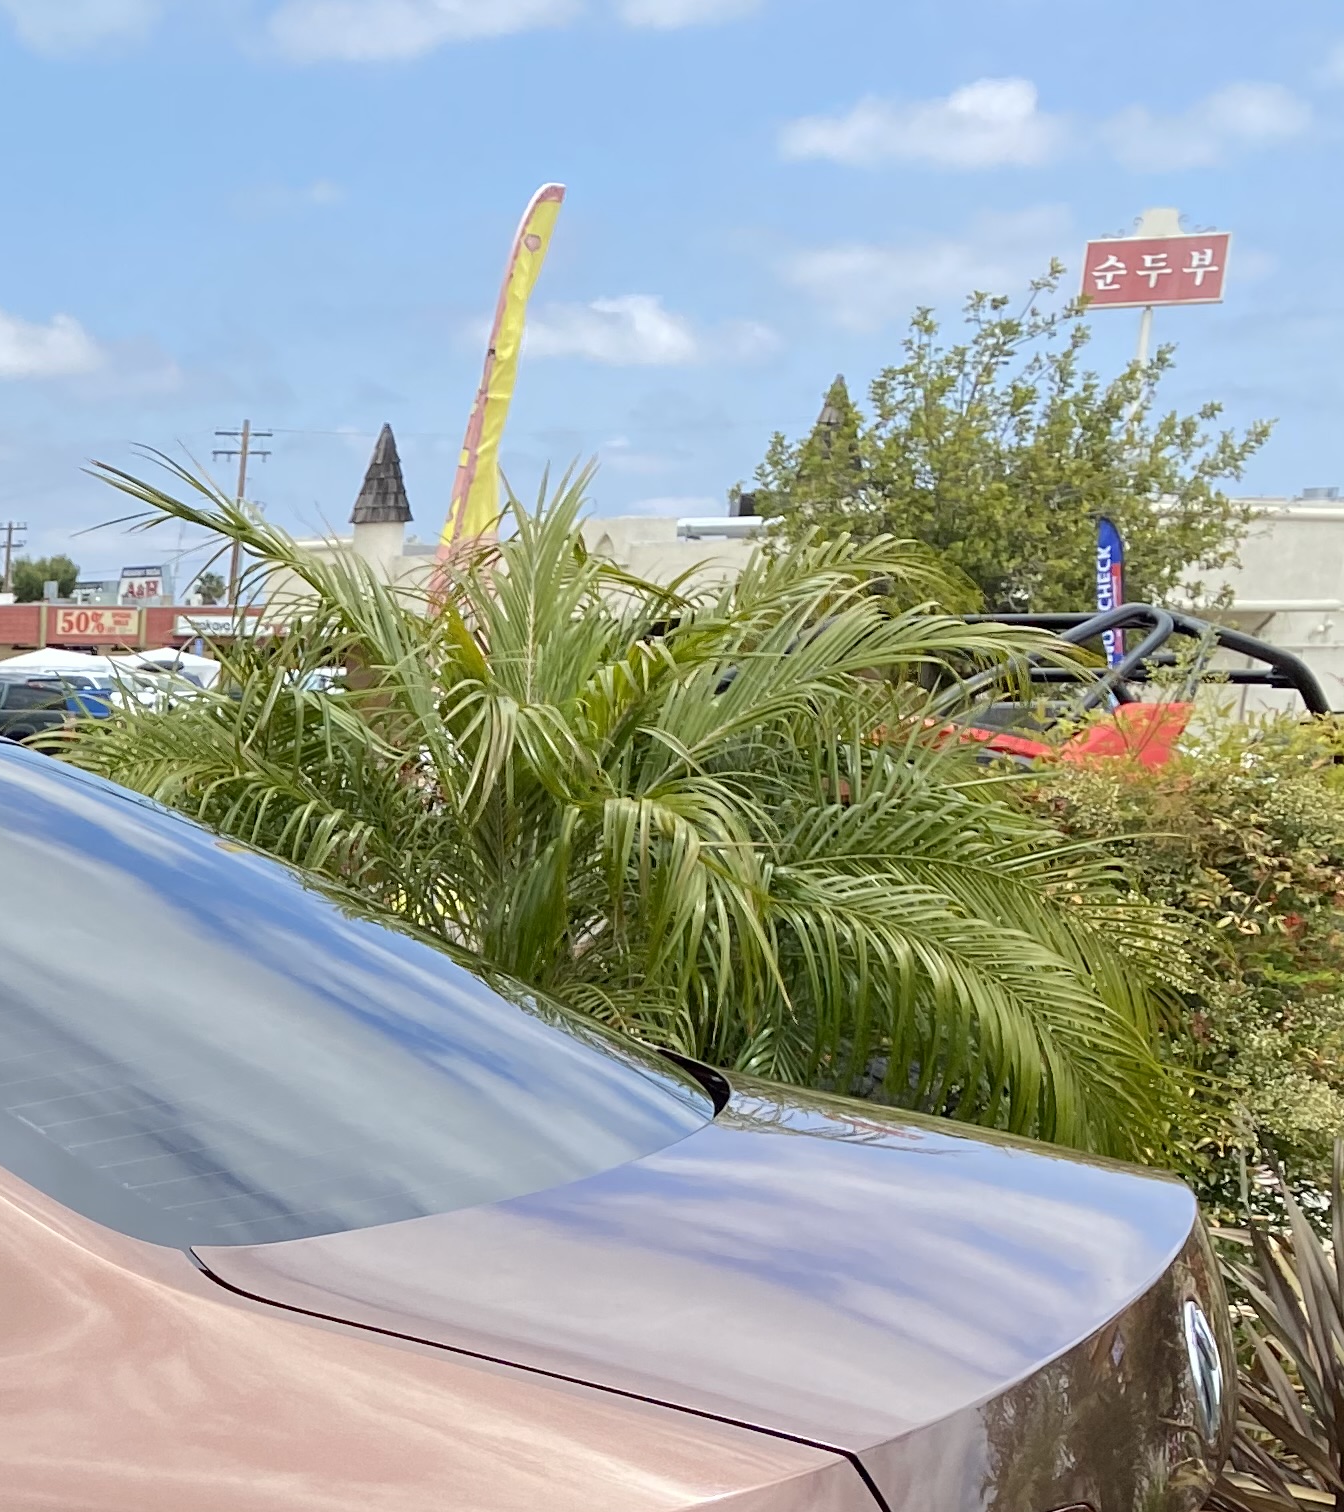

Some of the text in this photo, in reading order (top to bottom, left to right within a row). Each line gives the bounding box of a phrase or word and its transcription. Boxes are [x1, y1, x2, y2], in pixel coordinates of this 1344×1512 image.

[1091, 248, 1219, 290] 순두부
[1097, 545, 1112, 611] CHECK
[62, 611, 105, 633] 50%
